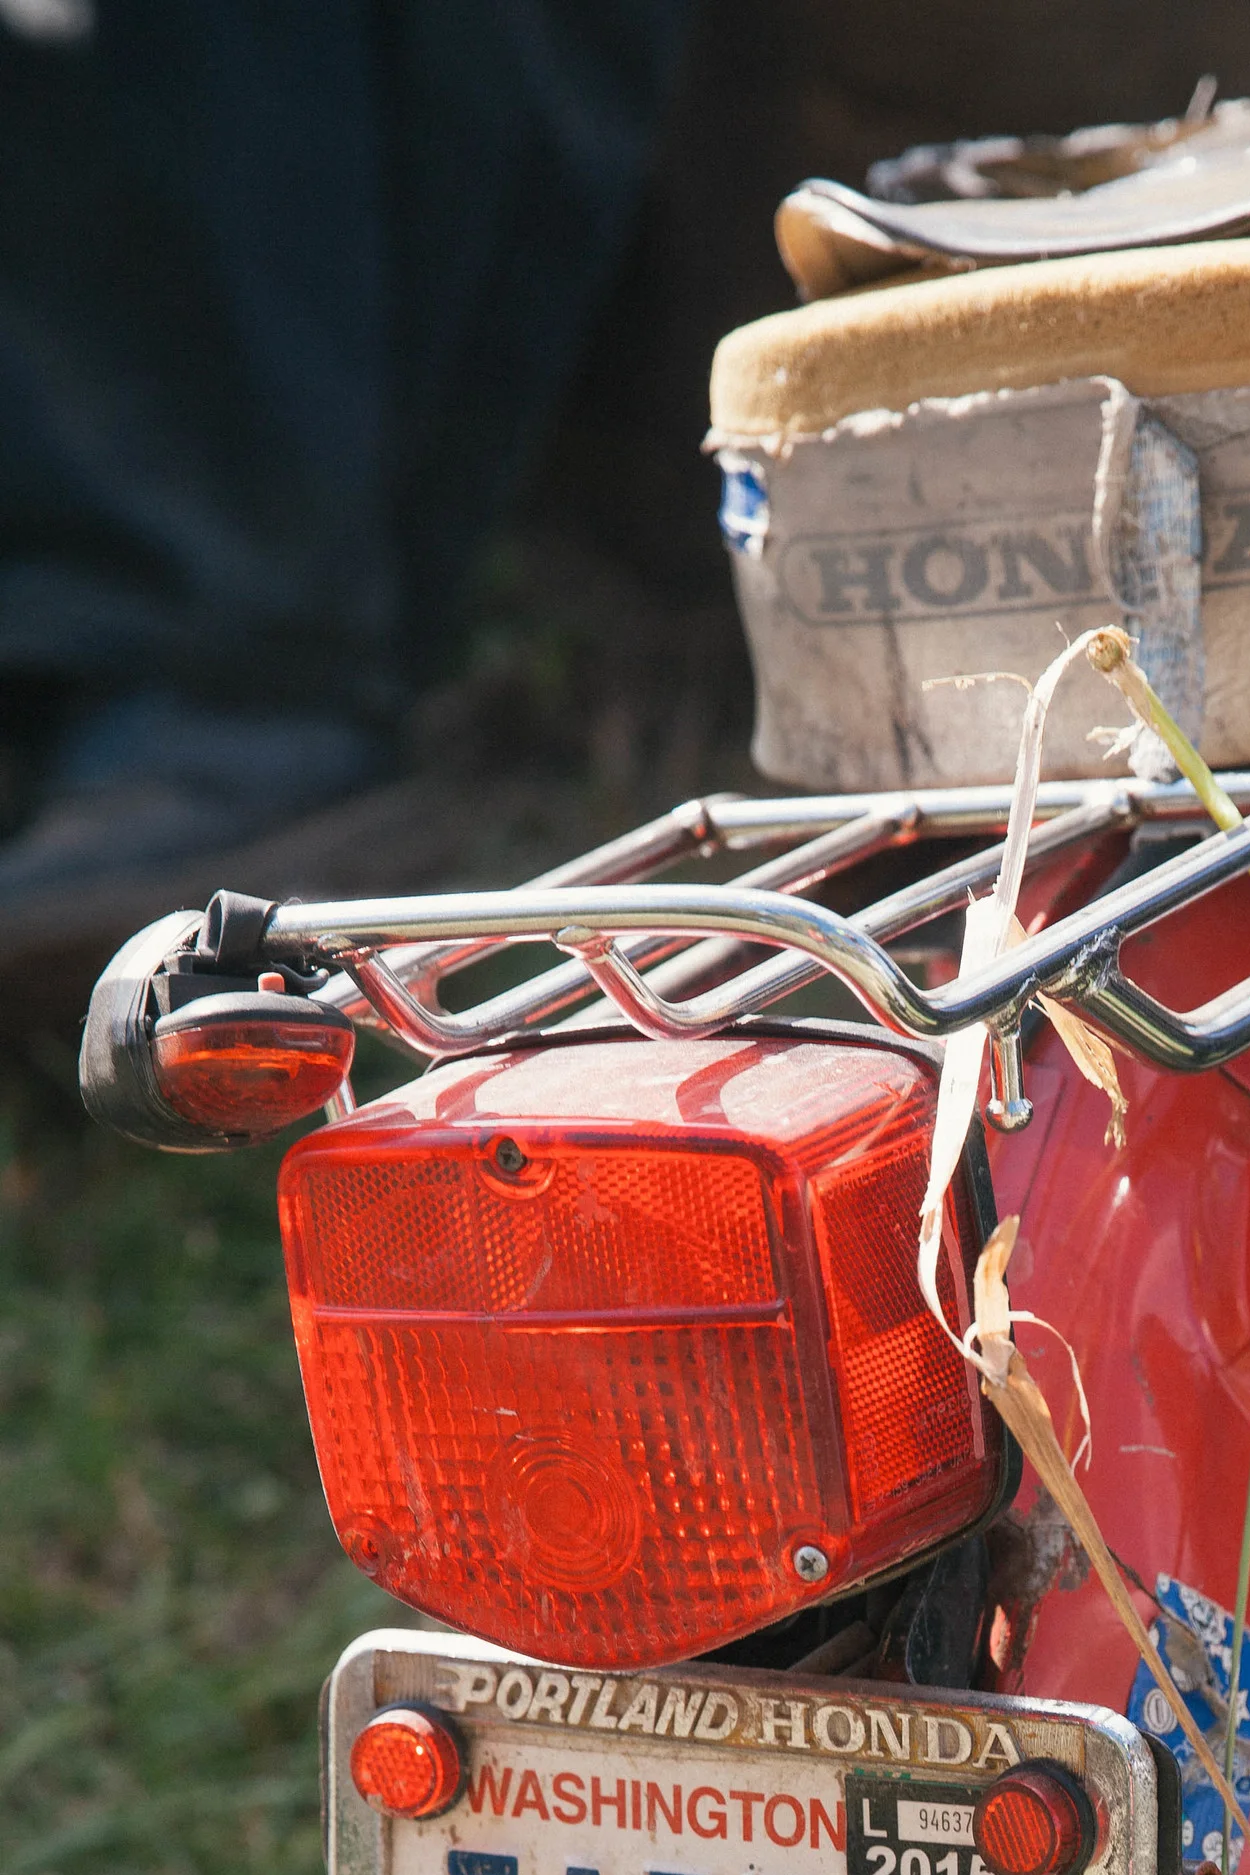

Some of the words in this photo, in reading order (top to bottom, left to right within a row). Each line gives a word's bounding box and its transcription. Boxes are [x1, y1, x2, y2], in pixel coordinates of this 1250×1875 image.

[456, 1665, 739, 1741] PORTLAND
[757, 1698, 1024, 1768] HONDA
[466, 1764, 846, 1854] WASHINGTON
[862, 1797, 888, 1839] L
